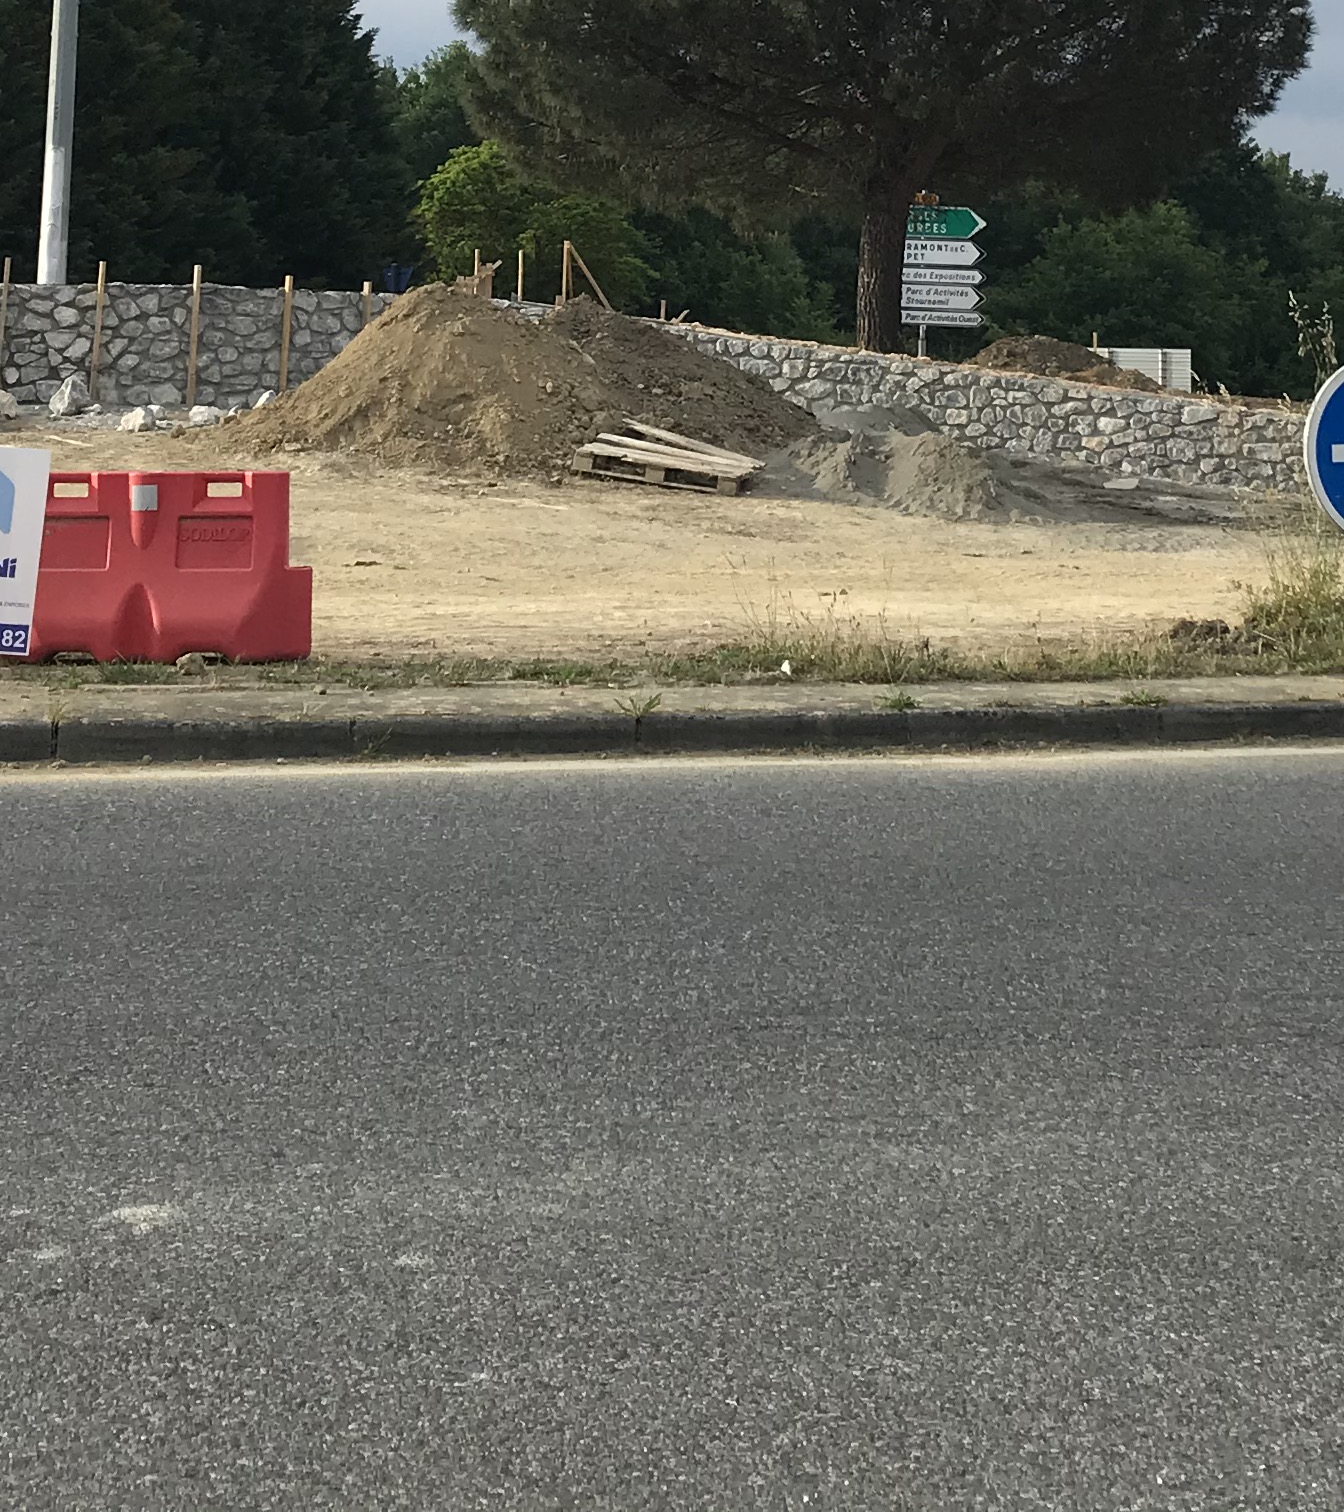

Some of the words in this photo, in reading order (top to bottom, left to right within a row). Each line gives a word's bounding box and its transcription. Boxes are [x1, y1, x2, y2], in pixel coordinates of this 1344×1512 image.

[907, 243, 949, 252] RAMONT
[907, 252, 925, 261] PET
[913, 271, 927, 279] des
[929, 272, 976, 282] Expositions
[905, 287, 923, 295] Parc
[926, 287, 969, 297] d'Activités
[905, 313, 921, 321] Parc
